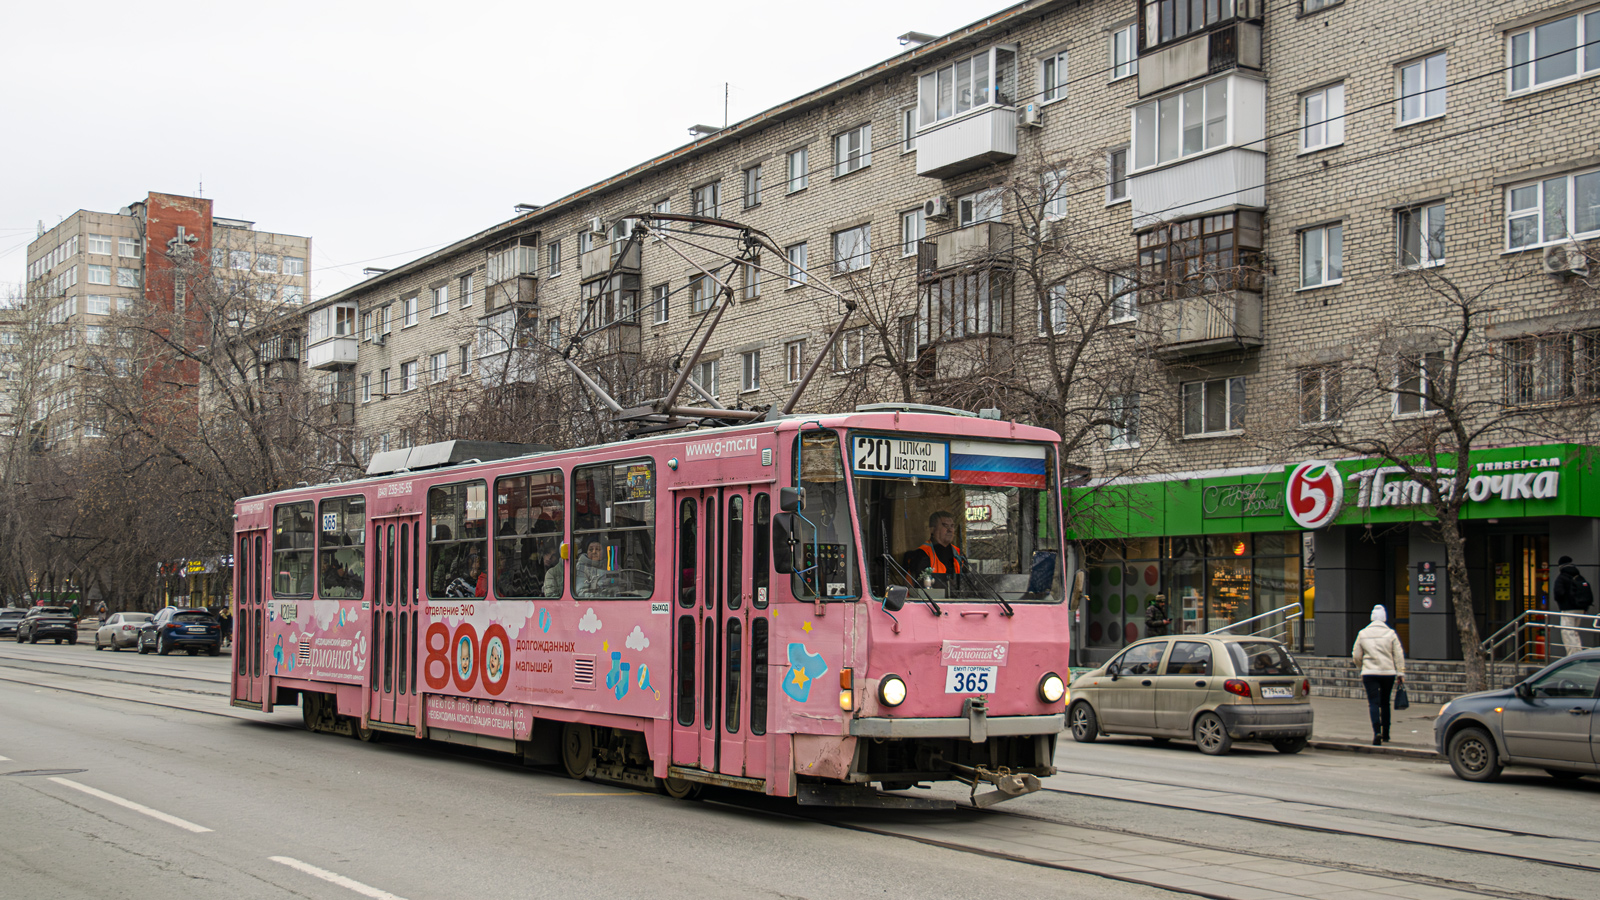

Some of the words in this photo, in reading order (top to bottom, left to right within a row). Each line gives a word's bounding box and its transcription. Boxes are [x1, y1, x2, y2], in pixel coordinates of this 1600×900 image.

[685, 437, 758, 457] www.g-mc.ru
[858, 438, 892, 471] 20
[898, 440, 932, 457] ЦПКиО
[894, 457, 937, 474] Шарташ
[1476, 457, 1560, 471] УНИВЕРСАМ
[1347, 466, 1559, 508] Пяточка
[965, 506, 989, 521] елое
[323, 515, 336, 531] 365
[425, 605, 459, 617] отделение
[460, 604, 475, 616] ЭКО
[652, 603, 669, 612] ВЫХОД
[516, 639, 576, 653] долгожданных
[943, 645, 992, 662] Гармония
[424, 622, 511, 696] 800
[515, 659, 553, 673] малышей
[953, 673, 988, 692] 365
[428, 699, 456, 710] ИМЕЮТСЯ
